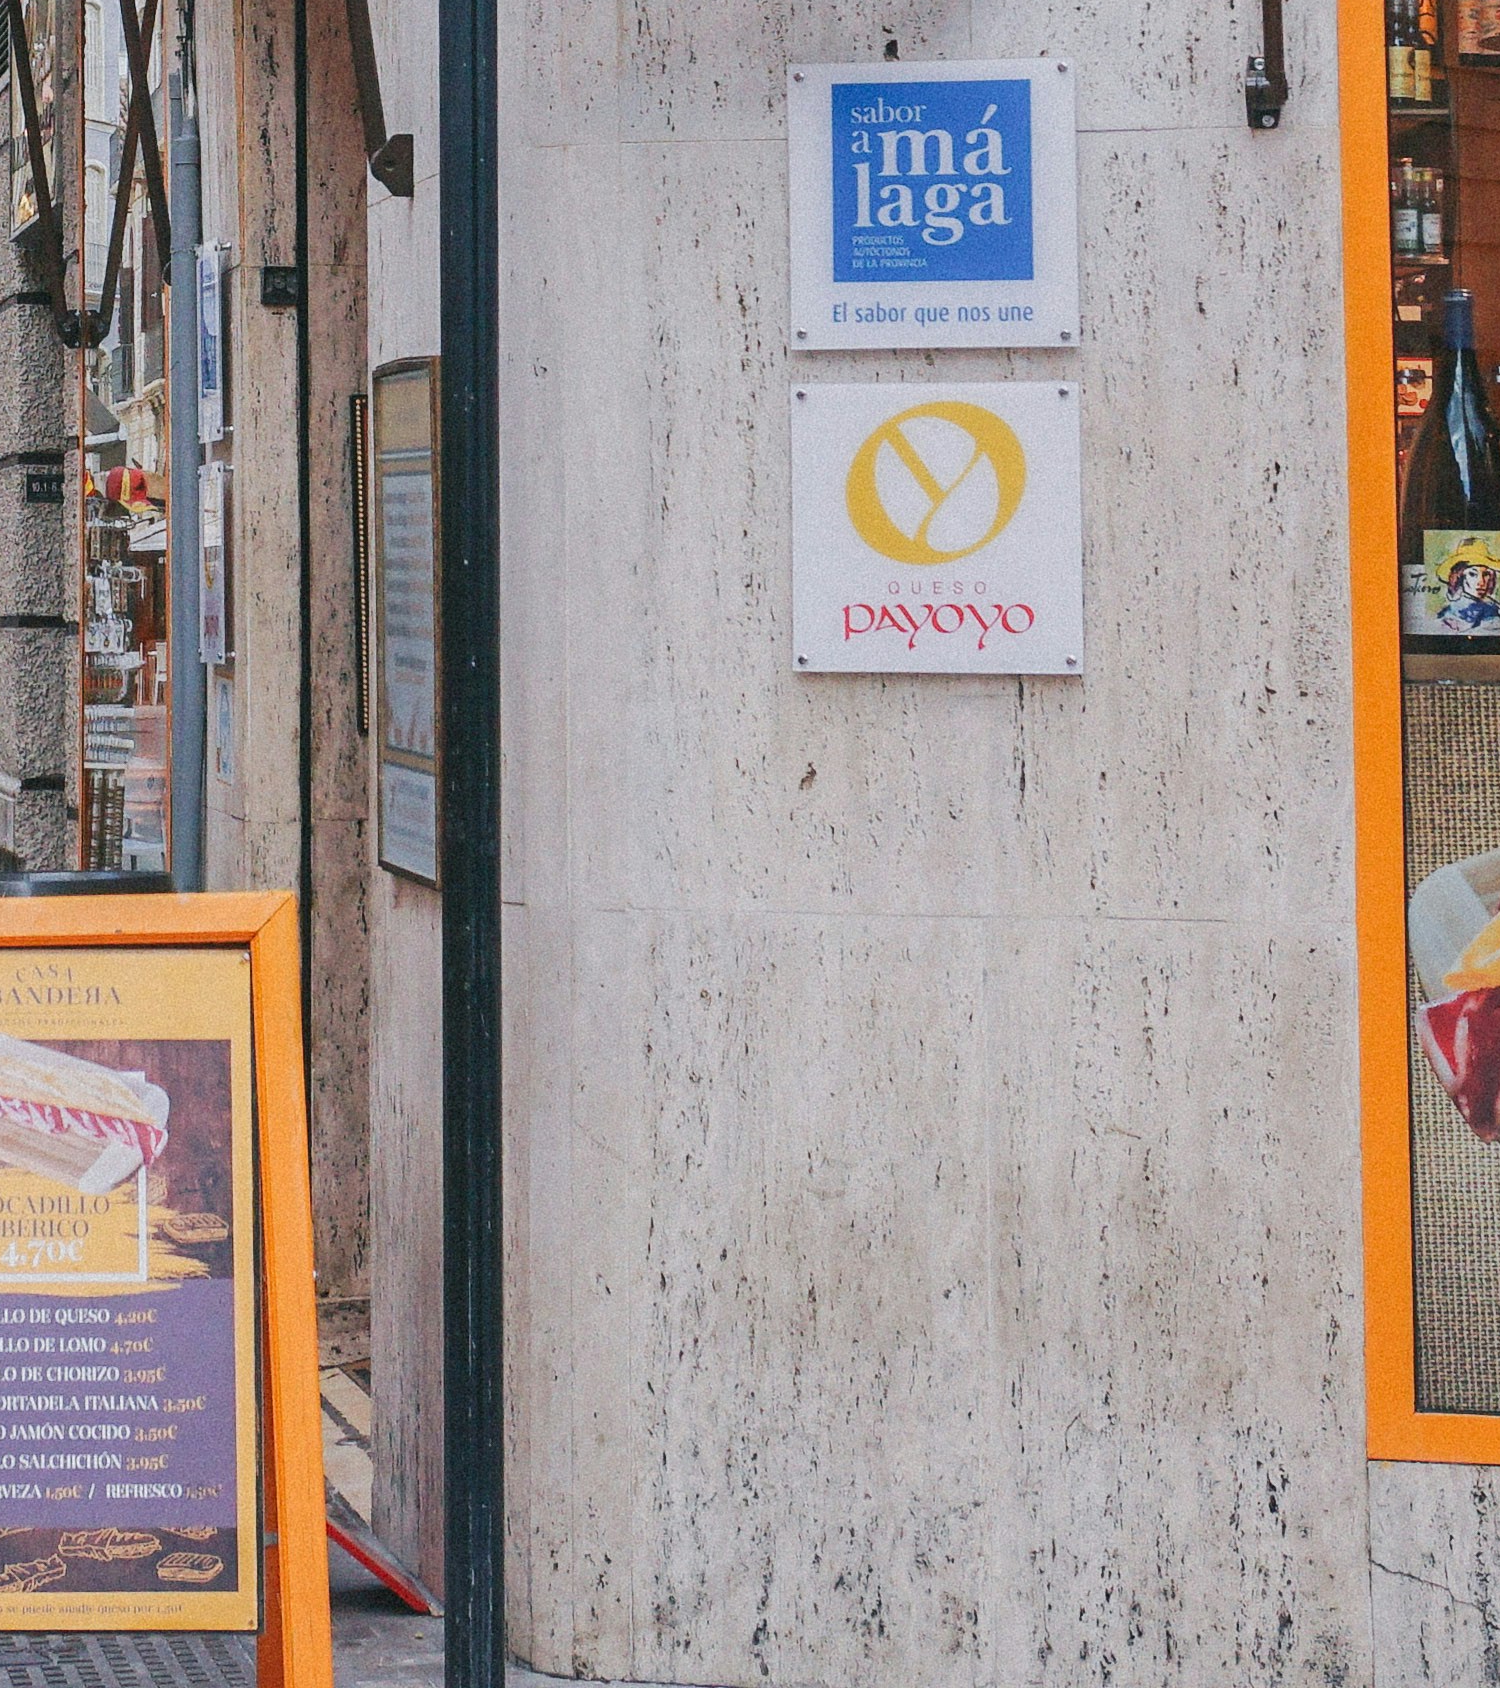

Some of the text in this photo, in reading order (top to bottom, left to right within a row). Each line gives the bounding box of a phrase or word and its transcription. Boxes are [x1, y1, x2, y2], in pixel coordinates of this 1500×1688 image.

[850, 97, 927, 124] sabor
[851, 129, 873, 154] a
[852, 162, 1013, 246] laga
[832, 301, 1034, 327] El sabor que nos une
[888, 580, 987, 595] QUESO
[29, 1309, 52, 1324] DE
[54, 1308, 110, 1326] QUESO
[33, 1337, 56, 1353] DE
[59, 1337, 107, 1353] LOMO
[21, 1366, 43, 1382] DE
[46, 1366, 120, 1382] CHORIZO
[84, 1395, 159, 1411] ITALIANA
[9, 1422, 65, 1440] JAMÓN
[68, 1424, 131, 1440] COCIDO
[18, 1450, 122, 1470] SALCHICHÓN
[105, 1484, 182, 1499] REFRESCO
